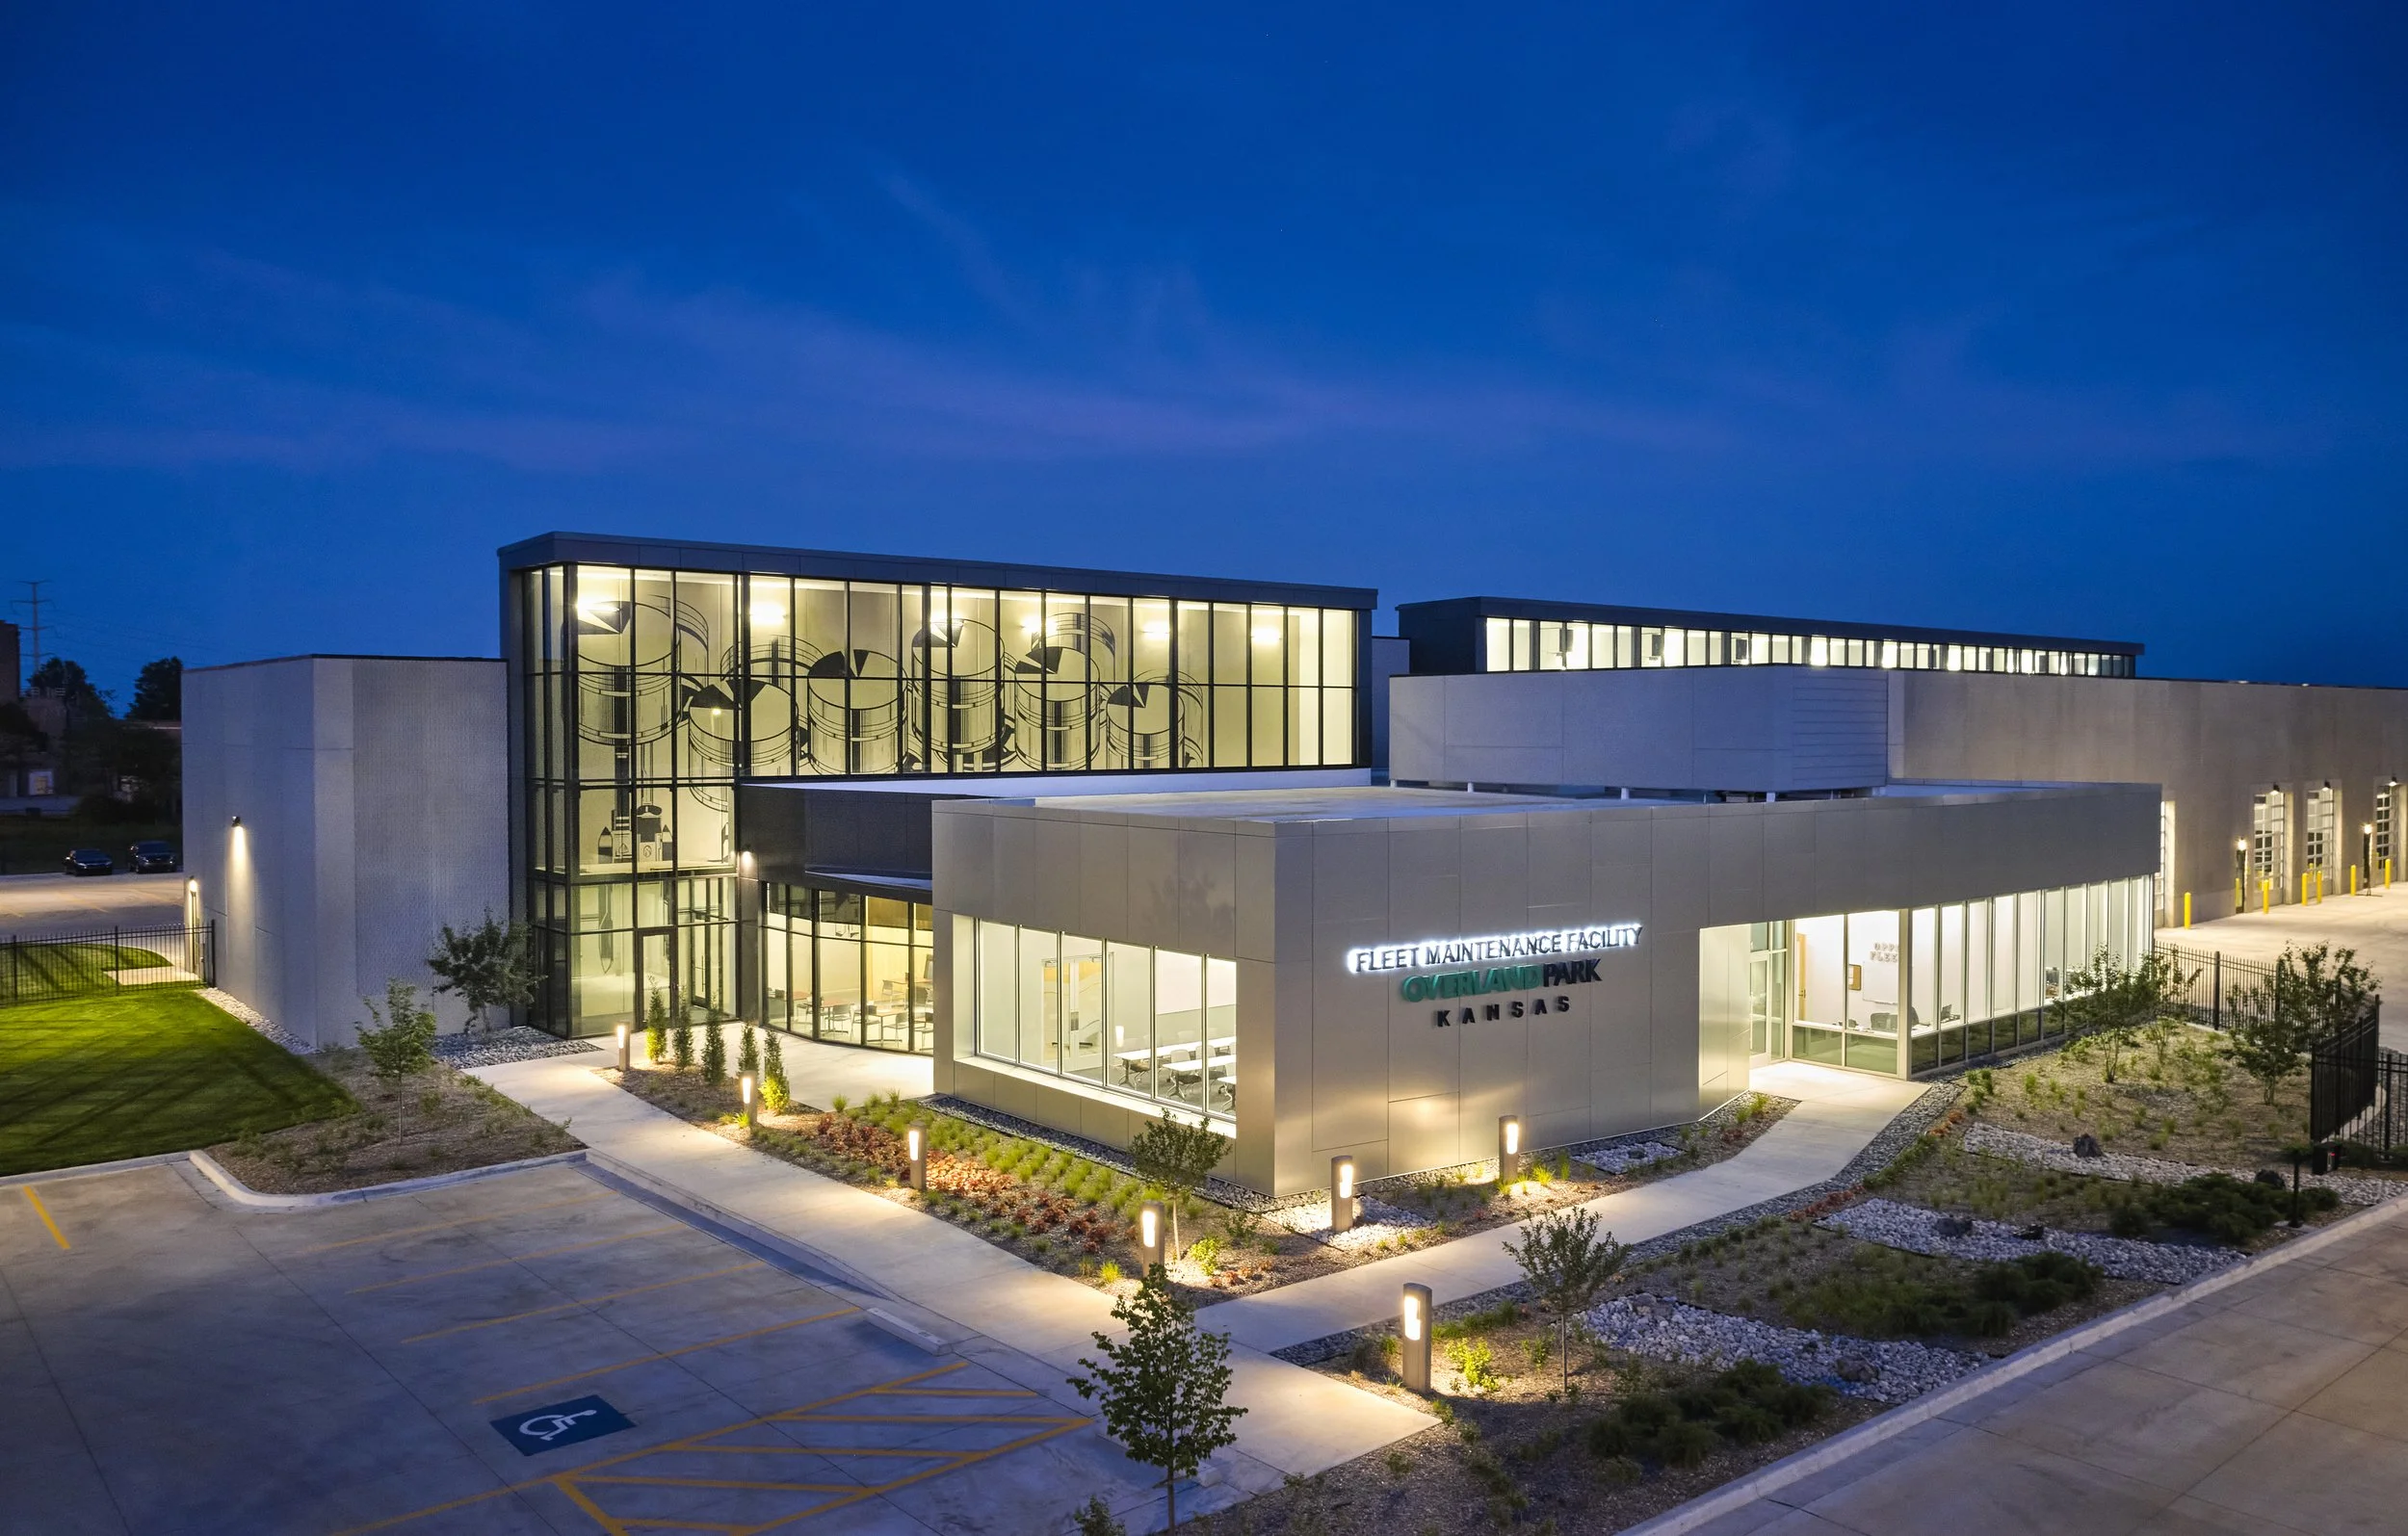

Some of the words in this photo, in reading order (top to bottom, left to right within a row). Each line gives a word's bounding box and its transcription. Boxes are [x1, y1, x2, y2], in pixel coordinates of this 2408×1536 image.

[1355, 948, 1420, 972] FLEET
[1426, 934, 1562, 965] MAINTENANCE
[1566, 925, 1643, 951] FACILITY
[1401, 964, 1541, 1002] OVERLAND
[1542, 958, 1602, 987] PARK
[1433, 996, 1570, 1028] KANSAS
